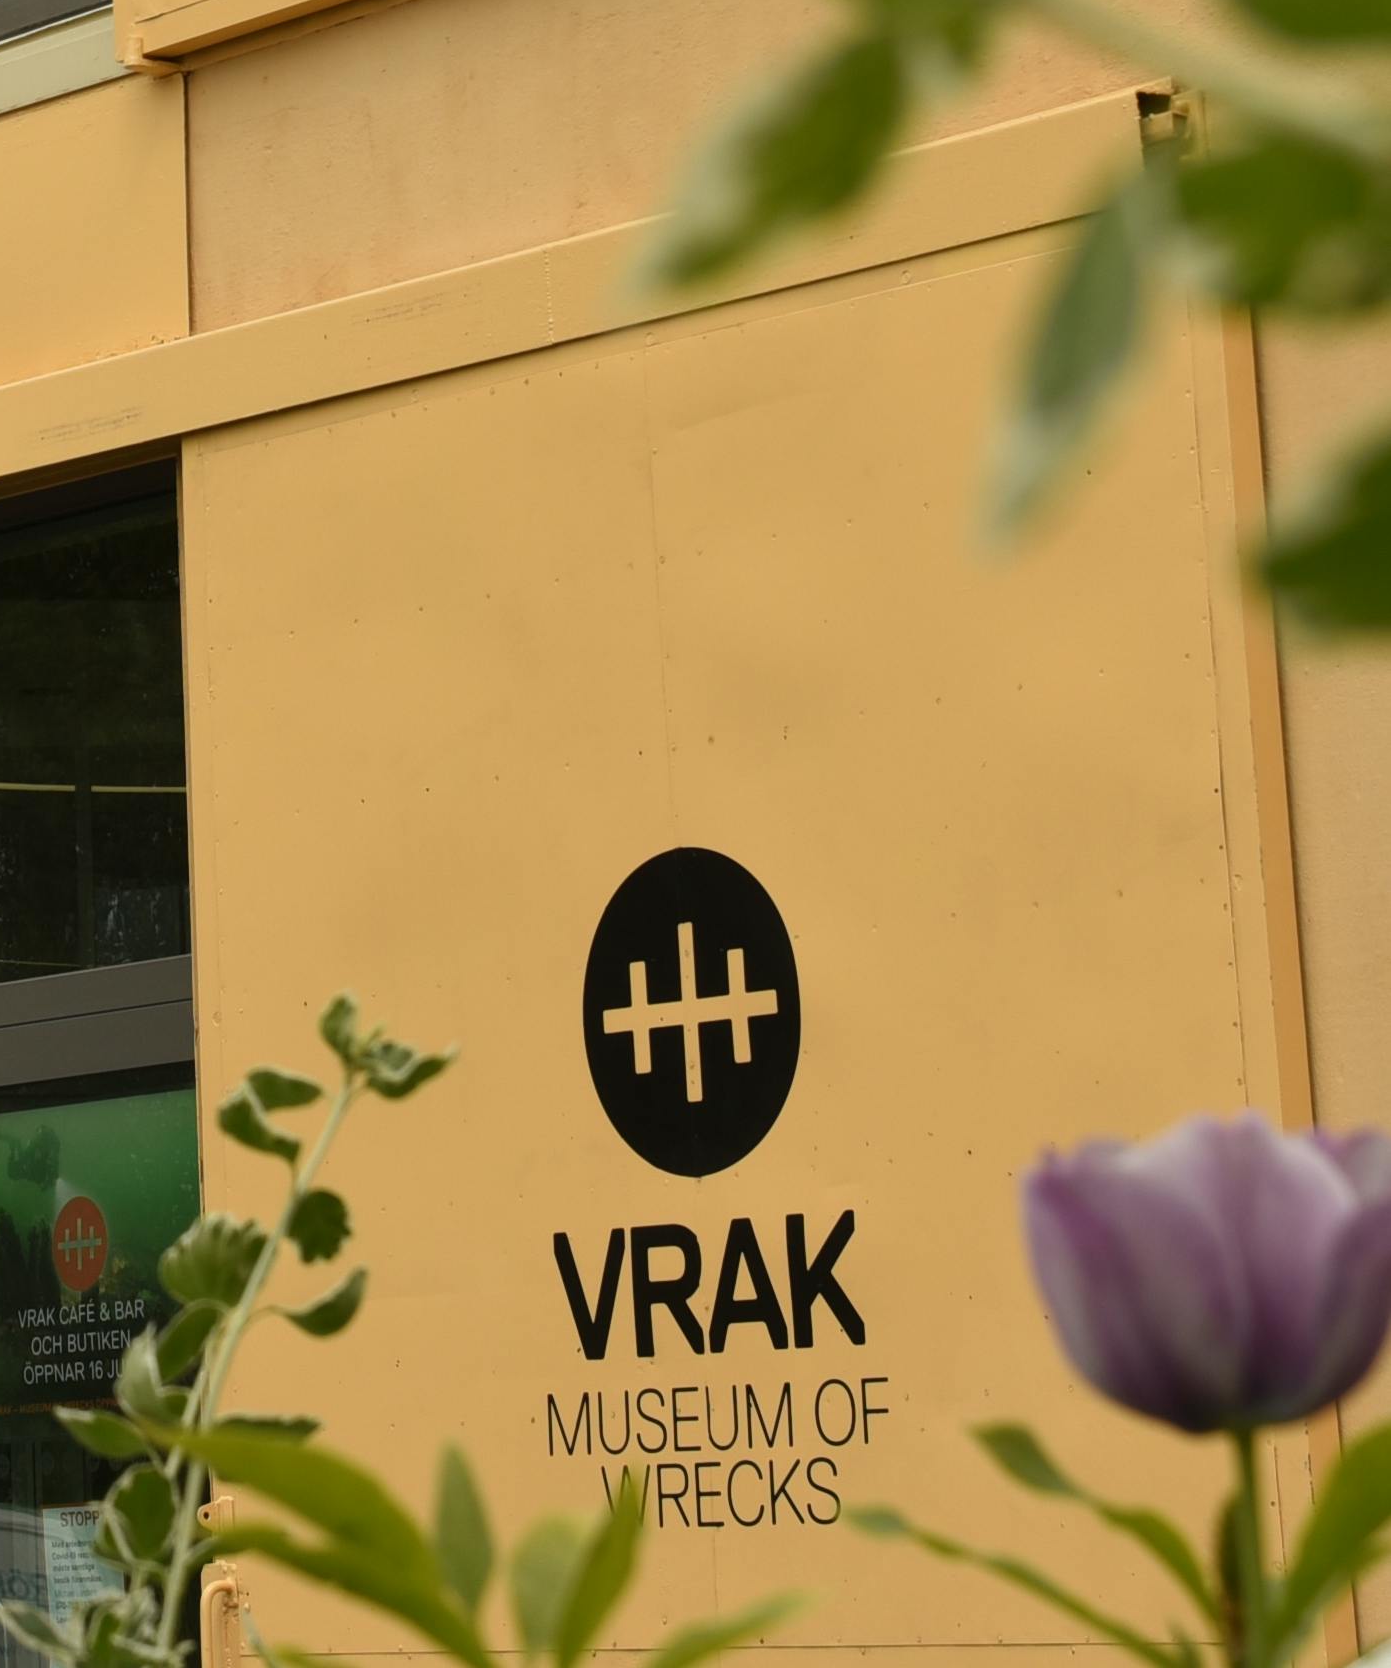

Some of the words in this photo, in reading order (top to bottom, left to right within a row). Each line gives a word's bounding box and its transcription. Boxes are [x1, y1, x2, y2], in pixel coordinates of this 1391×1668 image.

[553, 1209, 867, 1361] VRAK
[17, 1307, 56, 1329] VRAK
[58, 1298, 96, 1325] CAFÉ
[99, 1302, 111, 1322] &
[114, 1298, 145, 1320] BAR
[30, 1334, 63, 1356] OCH
[67, 1329, 131, 1353] BUTIKEN
[23, 1361, 86, 1385] ÖPPNAR
[88, 1359, 104, 1380] 16
[546, 1381, 795, 1456] MUSEUM
[814, 1377, 889, 1447] OF
[601, 1457, 841, 1529] WRECKS
